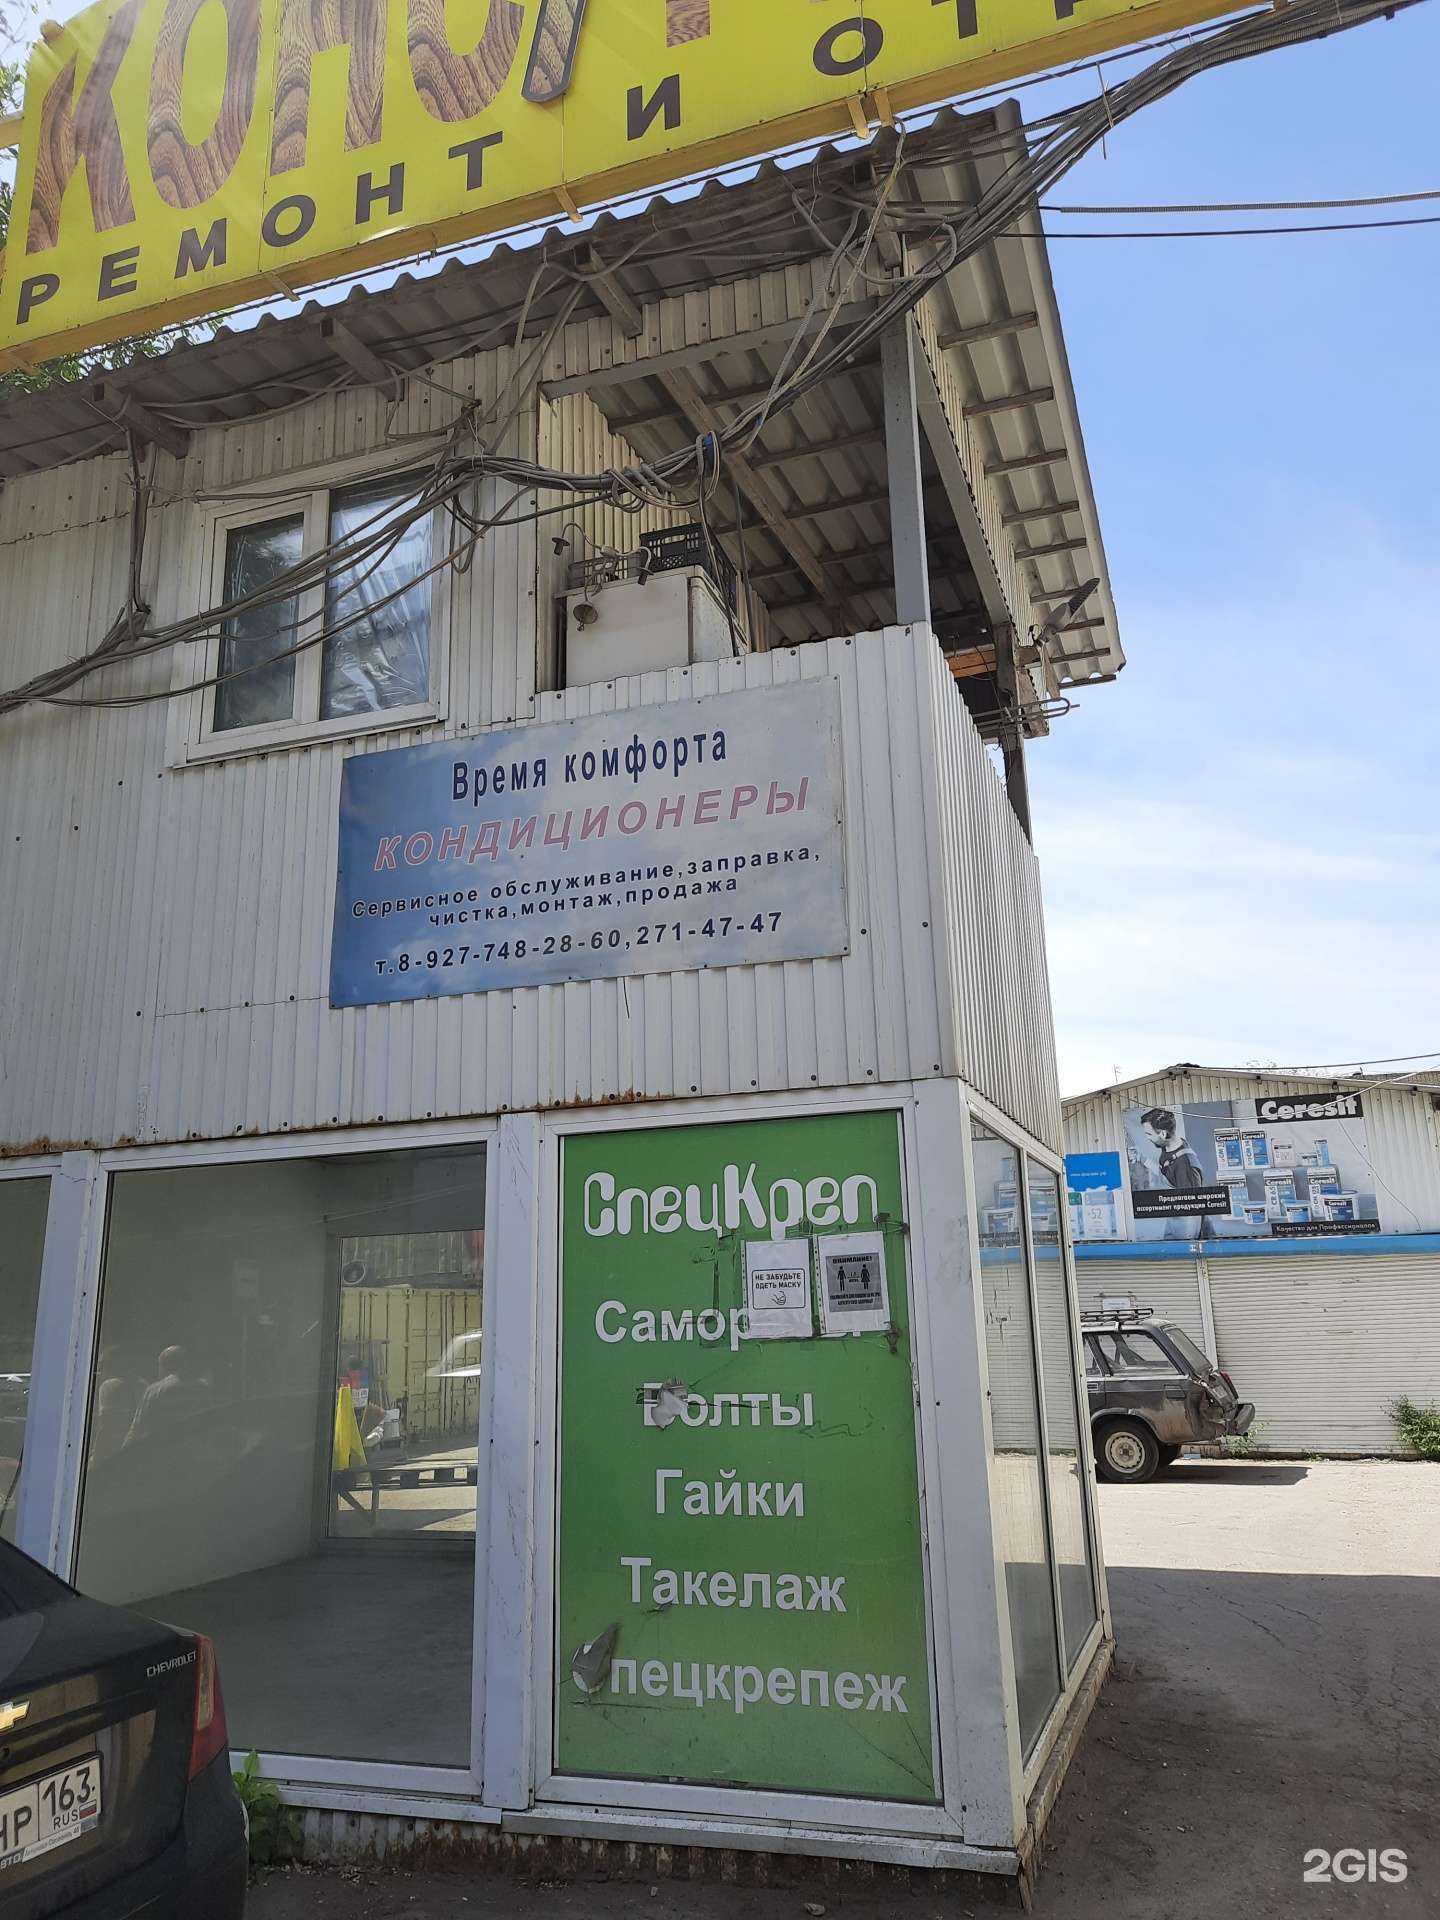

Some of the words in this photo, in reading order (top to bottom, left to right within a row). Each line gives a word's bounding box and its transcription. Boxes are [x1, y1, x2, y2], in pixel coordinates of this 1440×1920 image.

[17, 132, 503, 325] РЕМОНТ
[627, 73, 681, 141] И
[451, 753, 548, 807] Время
[564, 729, 728, 784] комфорта
[373, 776, 809, 872] КОНДИЦИОНЕРЫ
[353, 888, 478, 918] Сервисное
[1261, 1094, 1358, 1121] Ceresit
[583, 1162, 879, 1241] СпецКреп
[755, 1273, 764, 1281] НЕ
[766, 1272, 801, 1281] ЗАБУДЬТЕ
[755, 1282, 777, 1290] ОДЕТЬ
[778, 1281, 801, 1289] МАСКУ
[655, 1468, 804, 1517] Гайки
[620, 1556, 848, 1612] Такелаж
[146, 1650, 197, 1678] CHEVROLET
[42, 1766, 90, 1817] 163
[53, 1809, 79, 1831] RUS
